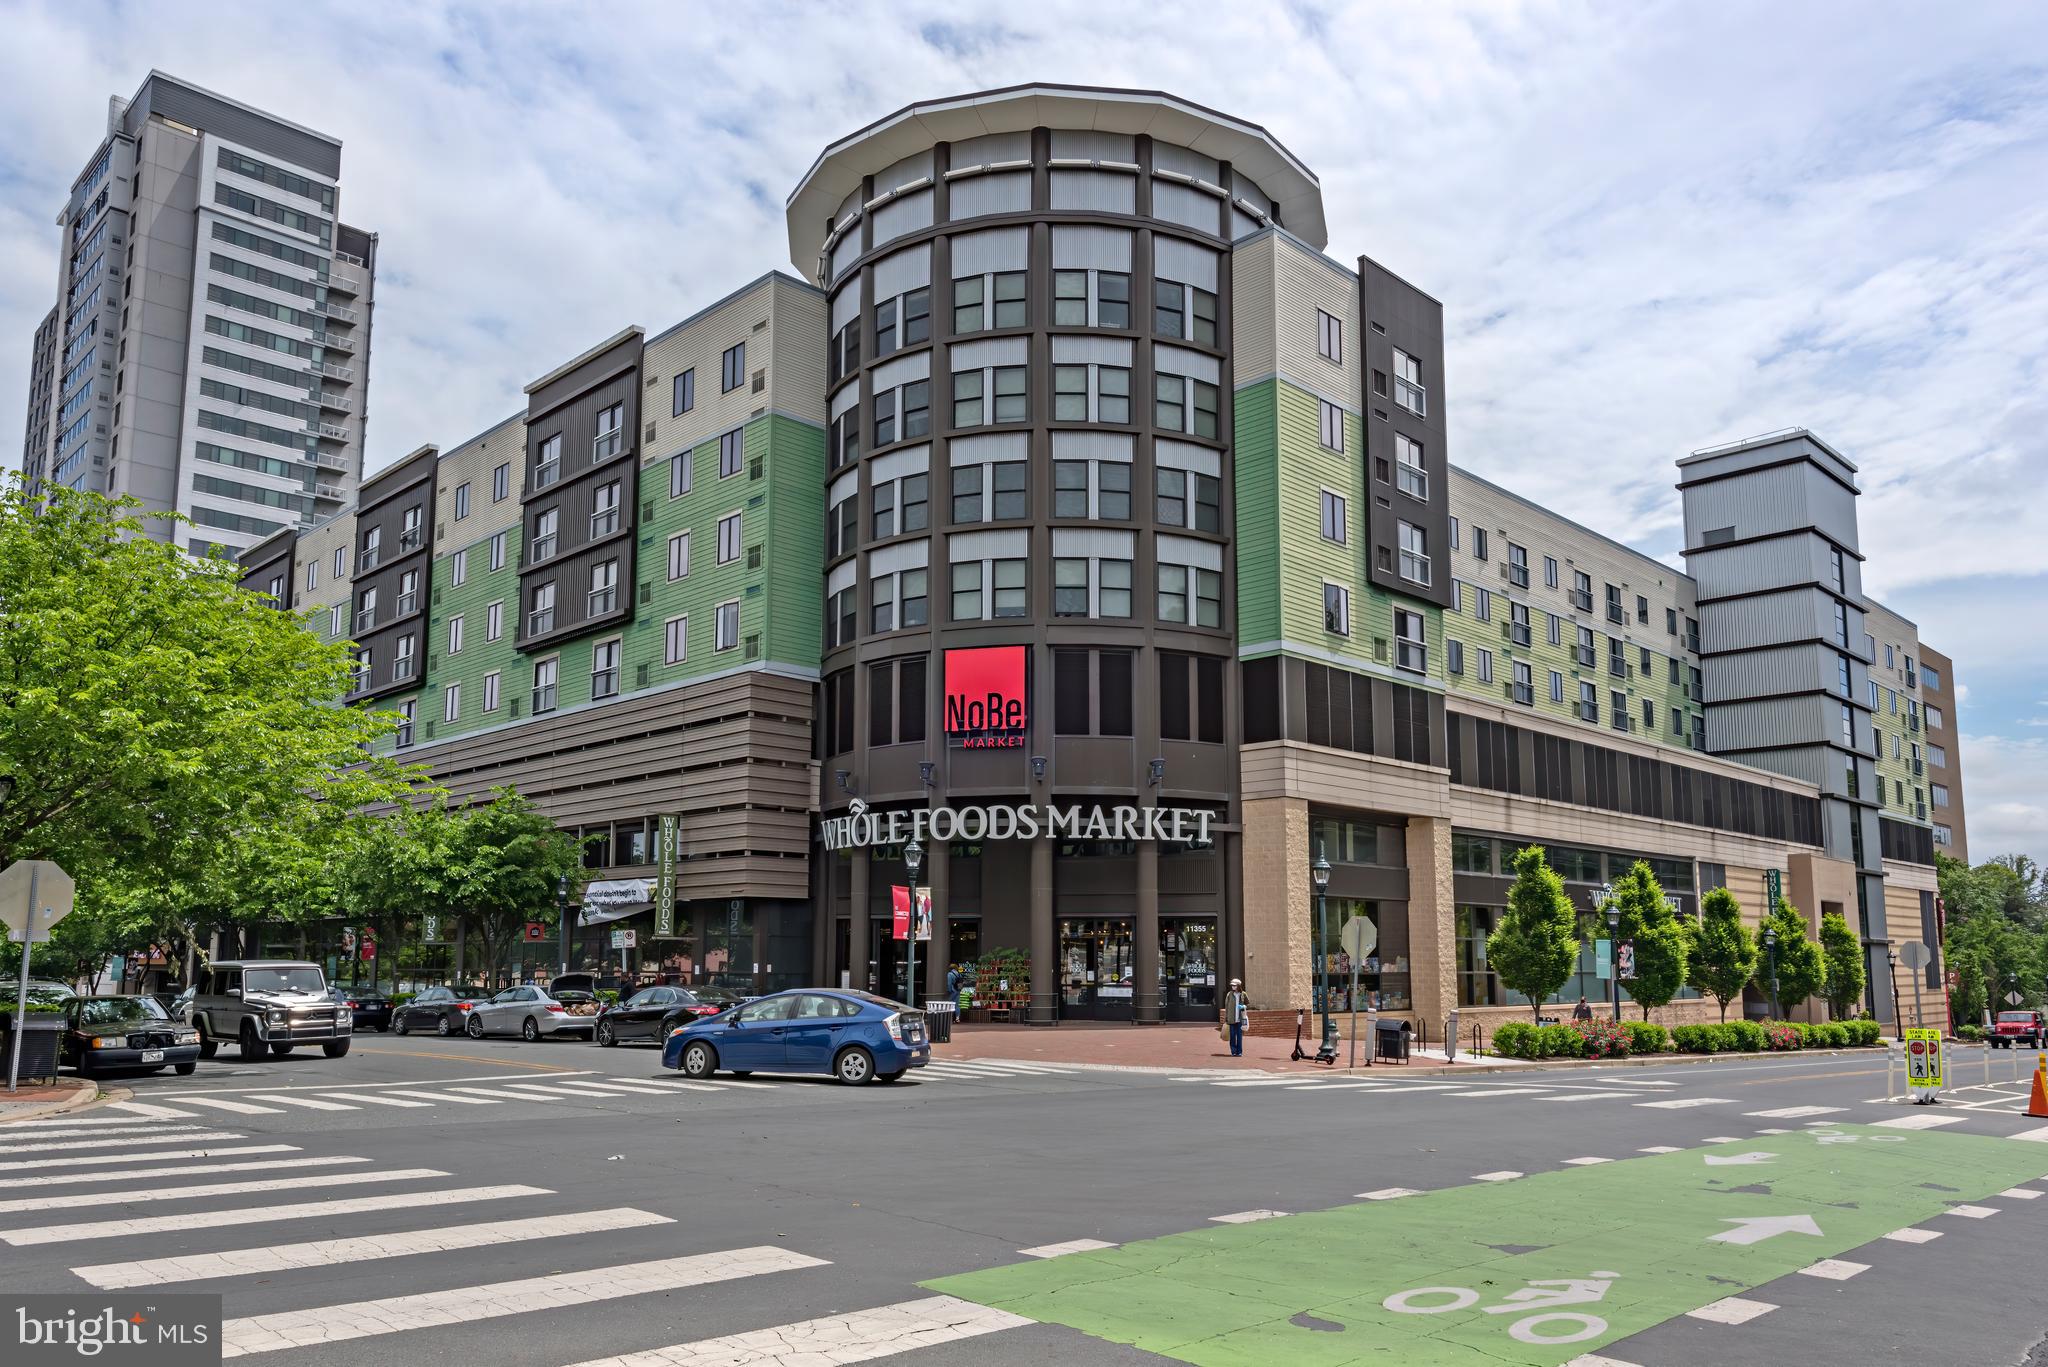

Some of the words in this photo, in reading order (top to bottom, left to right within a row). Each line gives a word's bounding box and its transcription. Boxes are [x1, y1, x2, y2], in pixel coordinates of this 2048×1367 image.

[947, 692, 1022, 732] NoBe
[963, 736, 1025, 749] MARKET
[663, 817, 675, 874] WHOLE
[821, 799, 908, 851] WHOLE
[911, 804, 1039, 842] FOODS
[1045, 804, 1216, 844] MARKET
[661, 876, 672, 930] FOODS
[1769, 870, 1778, 906] WHOLE
